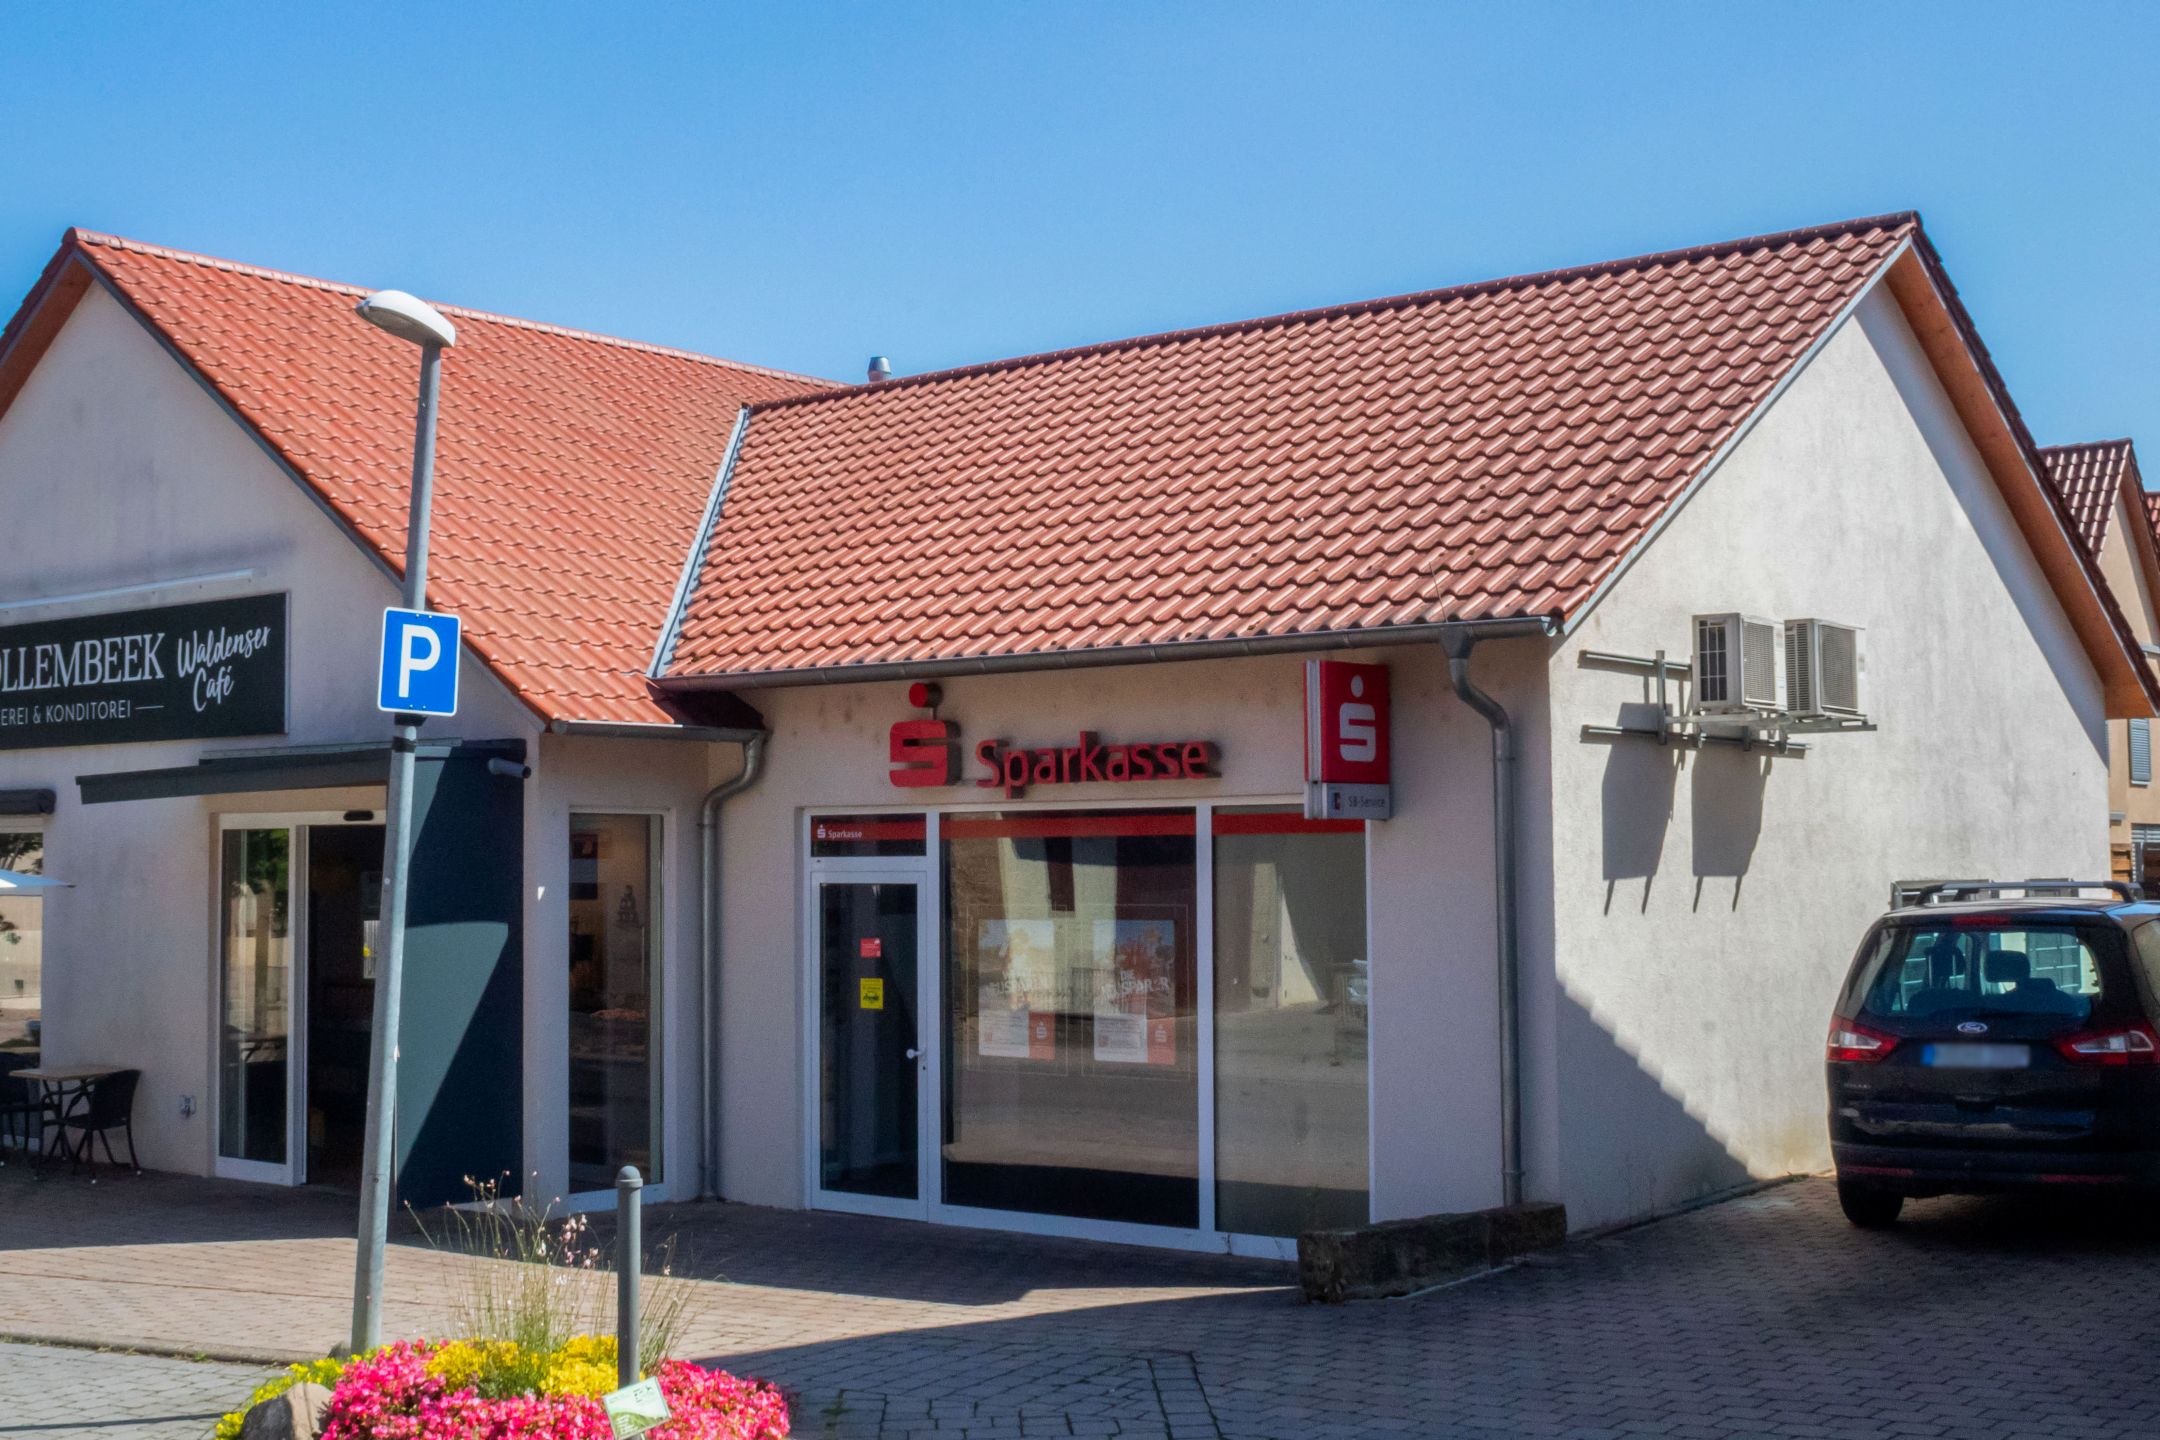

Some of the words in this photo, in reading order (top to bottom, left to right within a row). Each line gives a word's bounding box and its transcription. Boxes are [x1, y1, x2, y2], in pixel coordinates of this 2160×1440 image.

[0, 633, 165, 692] LLEMBEEK
[177, 627, 270, 678] Waldenser
[399, 624, 441, 698] P
[1, 707, 28, 726] EREI
[46, 700, 131, 723] KONDITOREI
[193, 666, 234, 712] Café
[976, 731, 1211, 799] Sparkasse
[828, 830, 862, 839] Sparkasse
